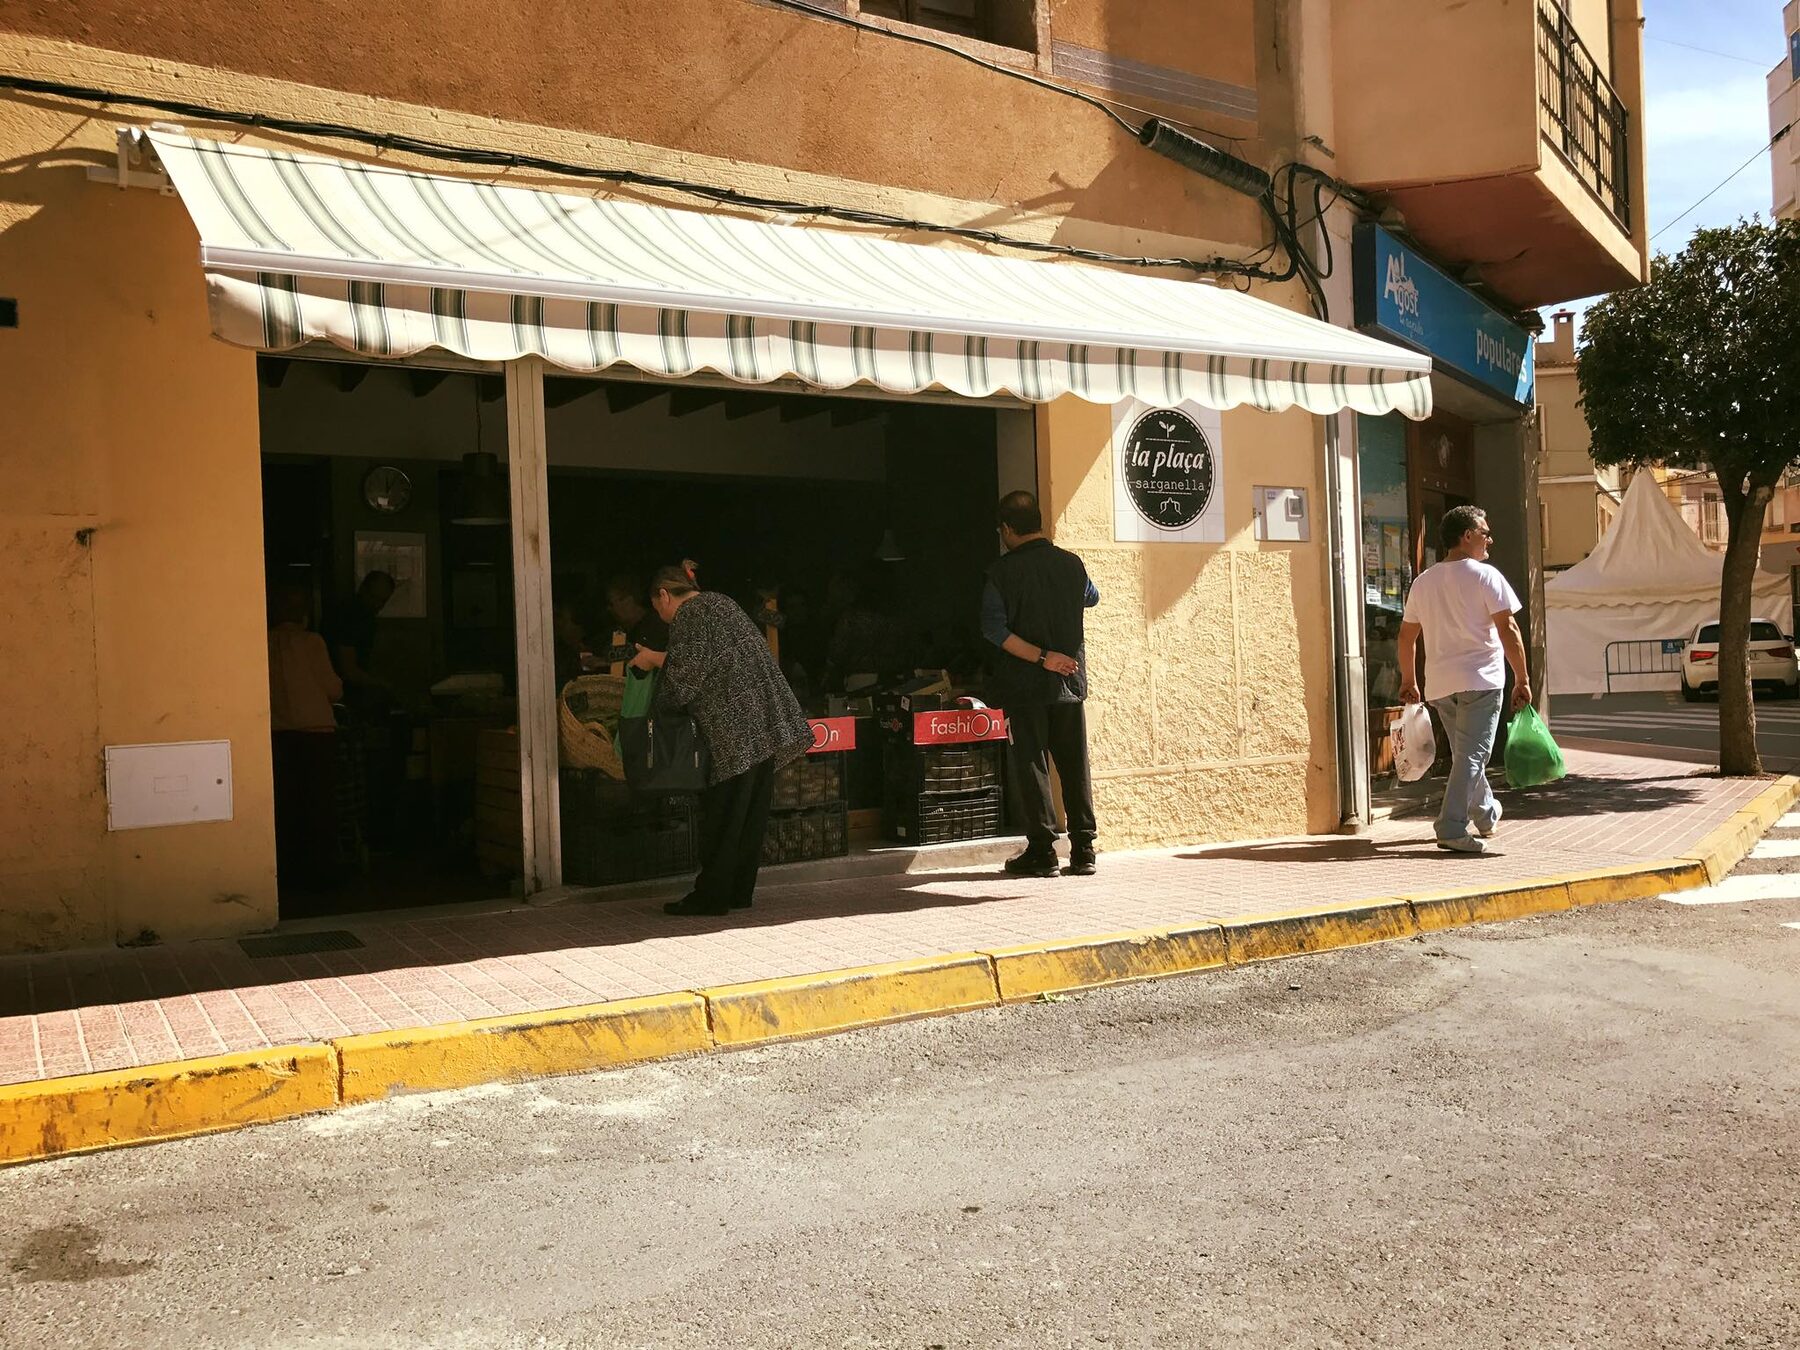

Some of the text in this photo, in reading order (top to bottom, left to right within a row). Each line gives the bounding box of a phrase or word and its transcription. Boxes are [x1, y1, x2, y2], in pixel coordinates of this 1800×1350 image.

[1476, 328, 1528, 383] populares
[1131, 441, 1204, 478] la plaça
[1135, 478, 1205, 493] sarganella
[930, 713, 1000, 737] fashiOn
